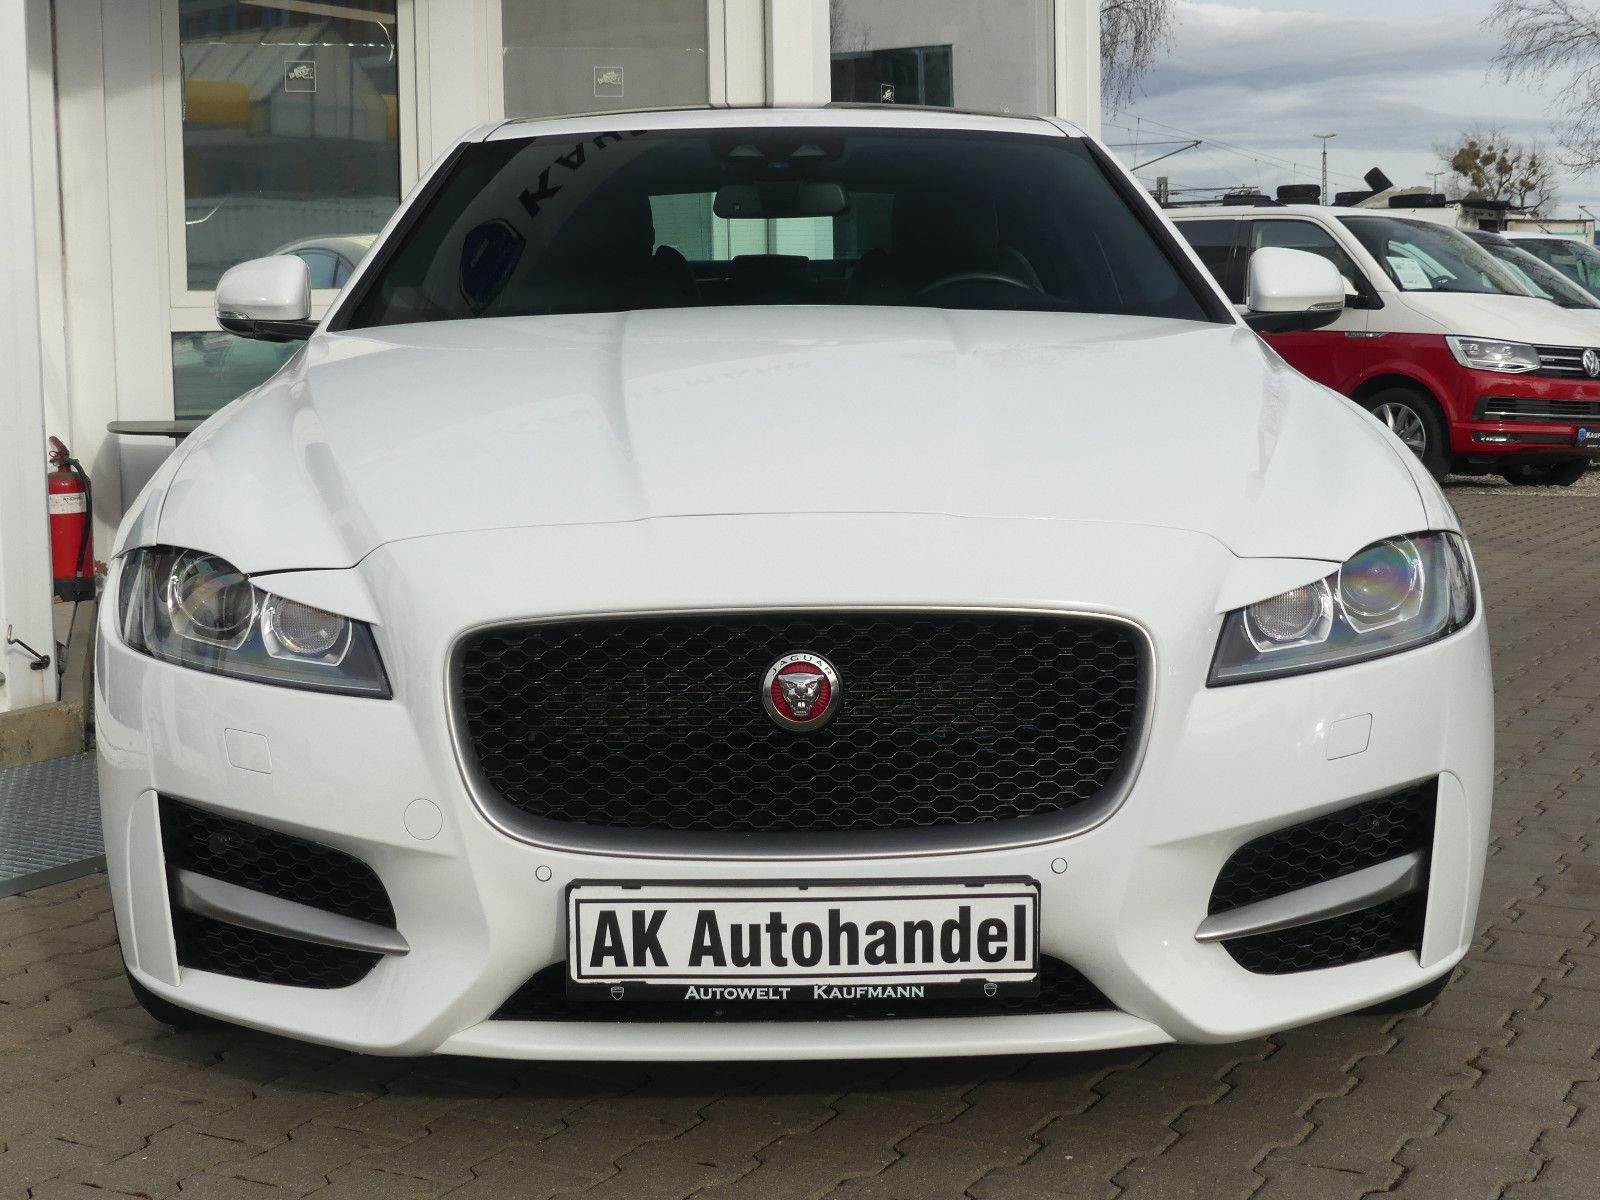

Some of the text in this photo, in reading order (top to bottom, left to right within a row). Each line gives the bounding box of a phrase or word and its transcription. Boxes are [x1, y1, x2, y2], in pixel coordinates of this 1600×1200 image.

[773, 654, 832, 676] JAGUAR
[589, 904, 1026, 968] AK Autohandel
[685, 983, 925, 1000] AUTOWELT KAUFMANN
